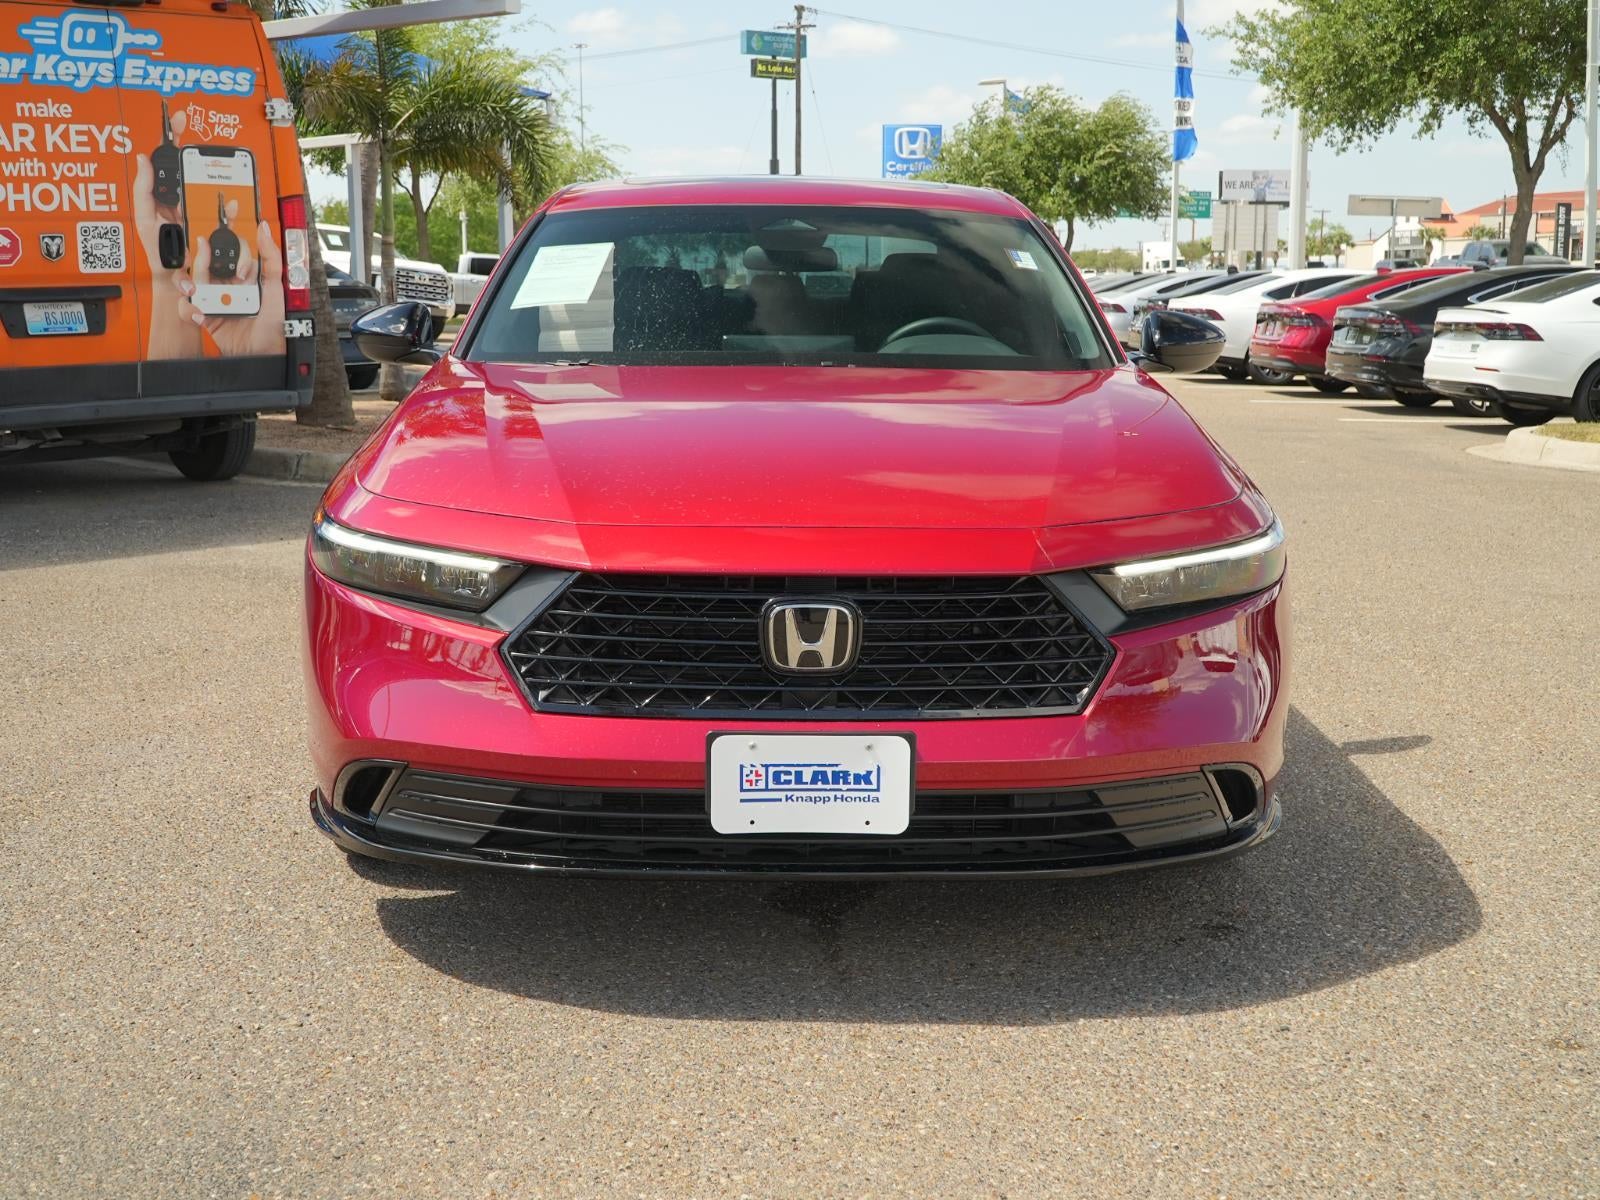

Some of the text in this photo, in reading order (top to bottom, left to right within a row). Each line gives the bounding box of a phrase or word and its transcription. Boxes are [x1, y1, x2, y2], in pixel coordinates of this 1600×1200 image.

[0, 53, 252, 92] ar Keys Express
[16, 98, 73, 118] make
[208, 110, 240, 127] Snap
[44, 123, 133, 154] KEYS
[1, 156, 98, 181] with your
[1224, 180, 1238, 190] WE
[772, 769, 874, 786] CLARK
[785, 793, 881, 805] Knapp Honda
